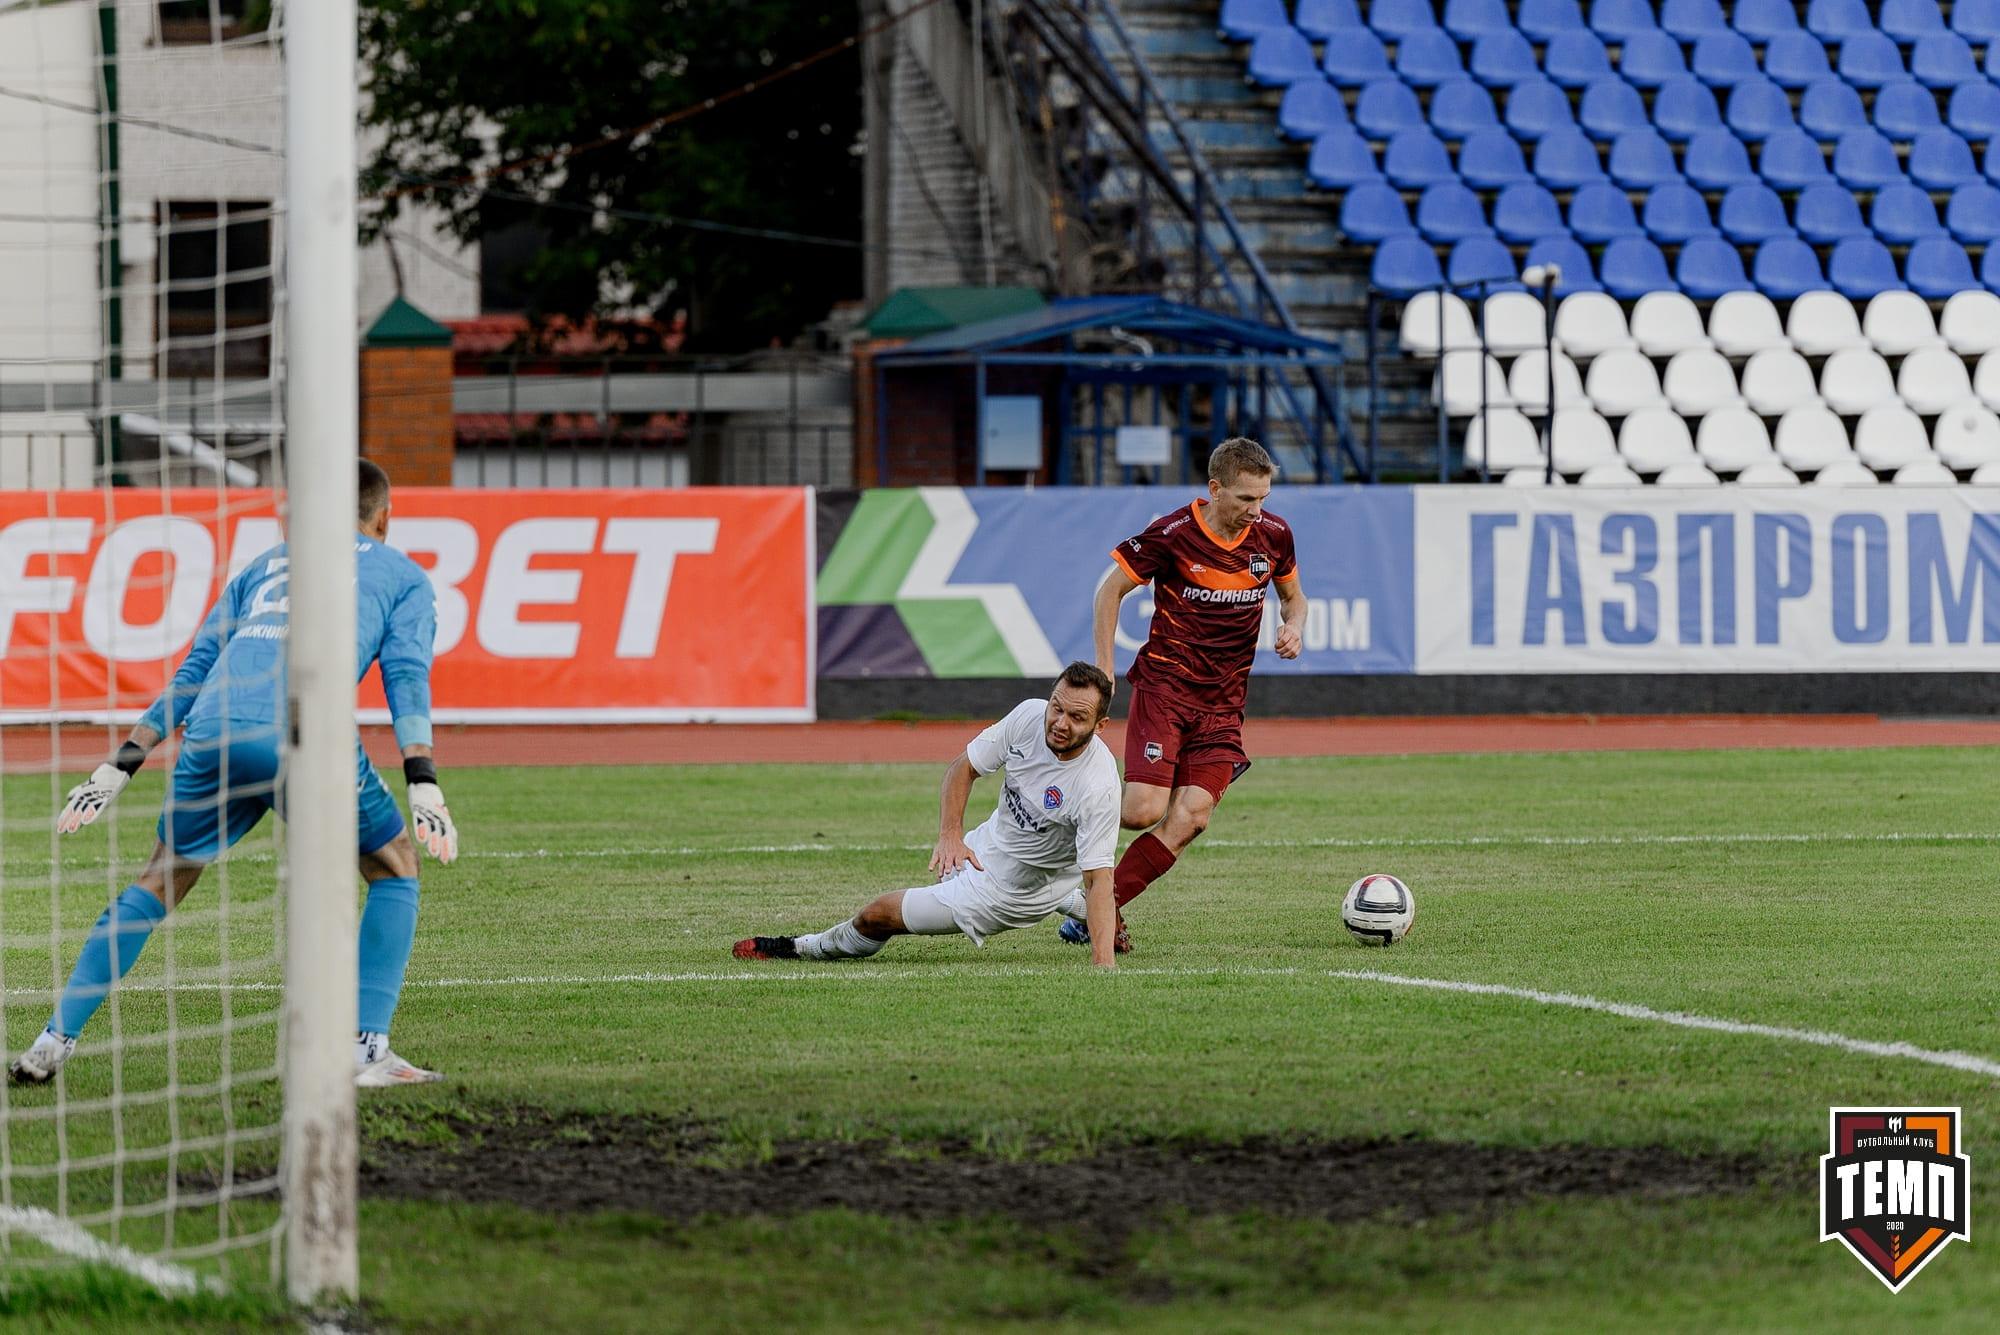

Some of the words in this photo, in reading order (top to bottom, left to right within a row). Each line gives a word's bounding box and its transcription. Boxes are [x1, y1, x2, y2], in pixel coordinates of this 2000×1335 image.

[0, 514, 720, 663] FOBET
[1182, 585, 1267, 603] ПРОДИНВЕС
[1469, 512, 2000, 646] ГАЗПРОМ
